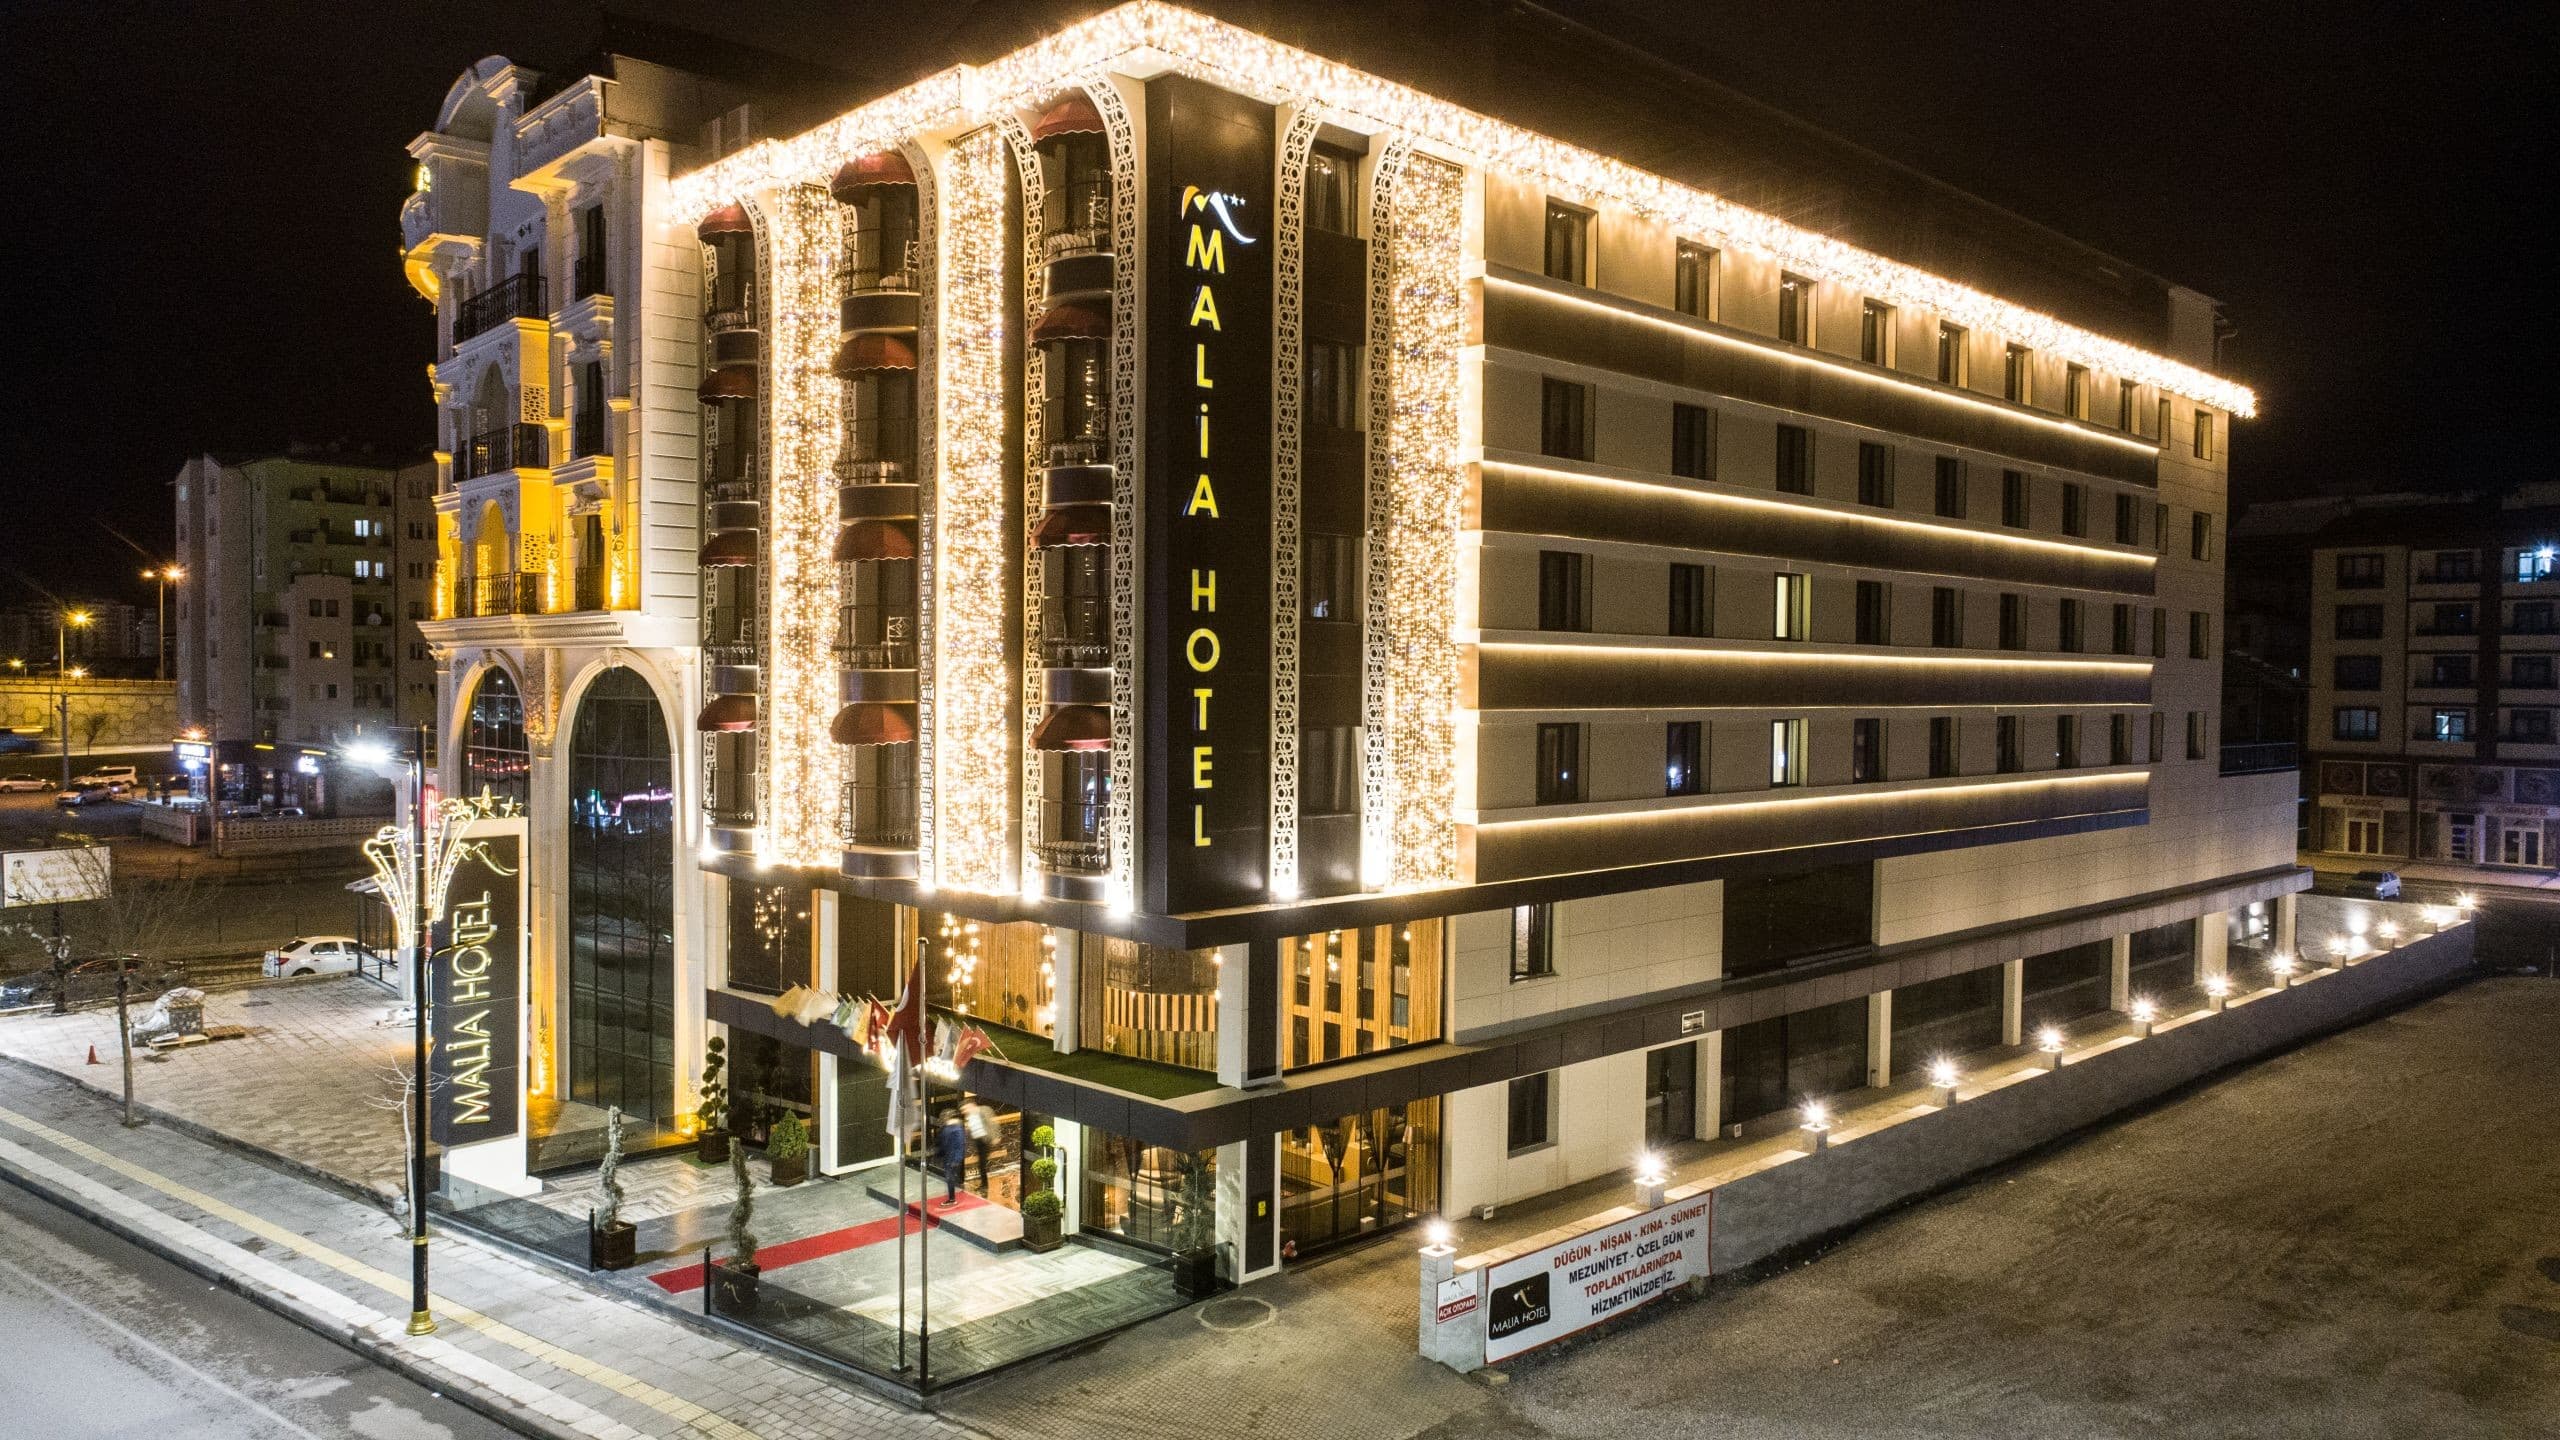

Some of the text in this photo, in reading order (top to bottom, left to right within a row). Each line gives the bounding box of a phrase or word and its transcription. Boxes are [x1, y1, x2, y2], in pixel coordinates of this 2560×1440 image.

[1185, 569, 1222, 848] HOTEL
[452, 890, 493, 1003] HOTEL
[1554, 1244, 1591, 1269] DÜĞÜN
[1600, 1230, 1632, 1251] NİŞAN
[1640, 1219, 1663, 1237] KINA
[1670, 1203, 1707, 1226] SÜNNET
[1569, 1251, 1628, 1284] MEZUNİYET
[1636, 1239, 1661, 1258] ÖZEL
[1663, 1229, 1683, 1247] GÜN
[1685, 1228, 1695, 1239] ve
[1584, 1249, 1682, 1298] TOPLANTILARINIZDA
[1522, 1305, 1548, 1323] HOTEL
